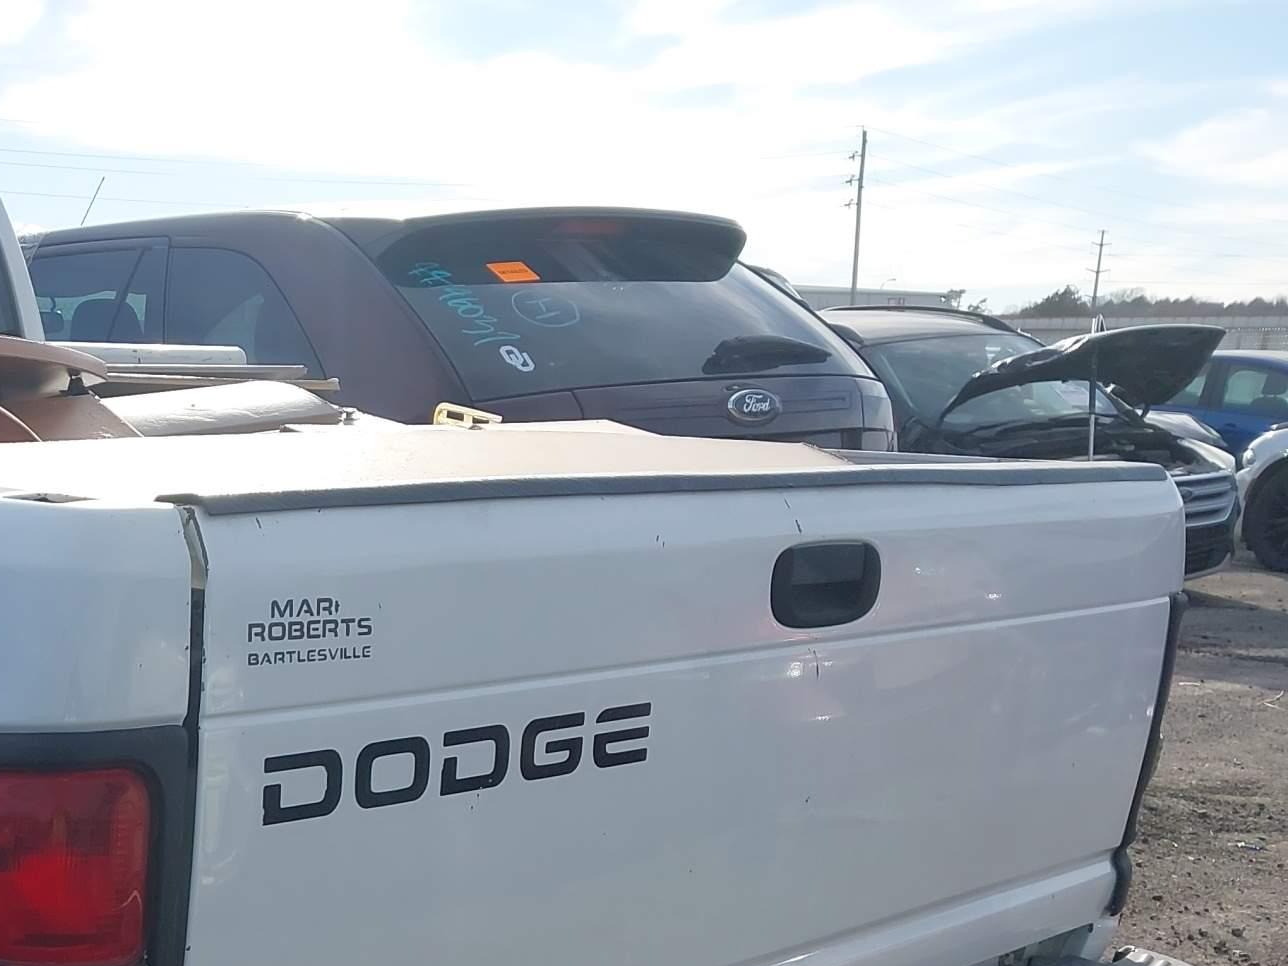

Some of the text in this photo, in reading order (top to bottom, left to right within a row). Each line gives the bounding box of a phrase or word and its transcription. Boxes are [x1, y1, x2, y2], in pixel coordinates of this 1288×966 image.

[743, 393, 771, 413] Ford
[247, 617, 373, 642] ROBERTS
[247, 645, 372, 666] BARTLESVILLE
[262, 702, 652, 826] DODGE
